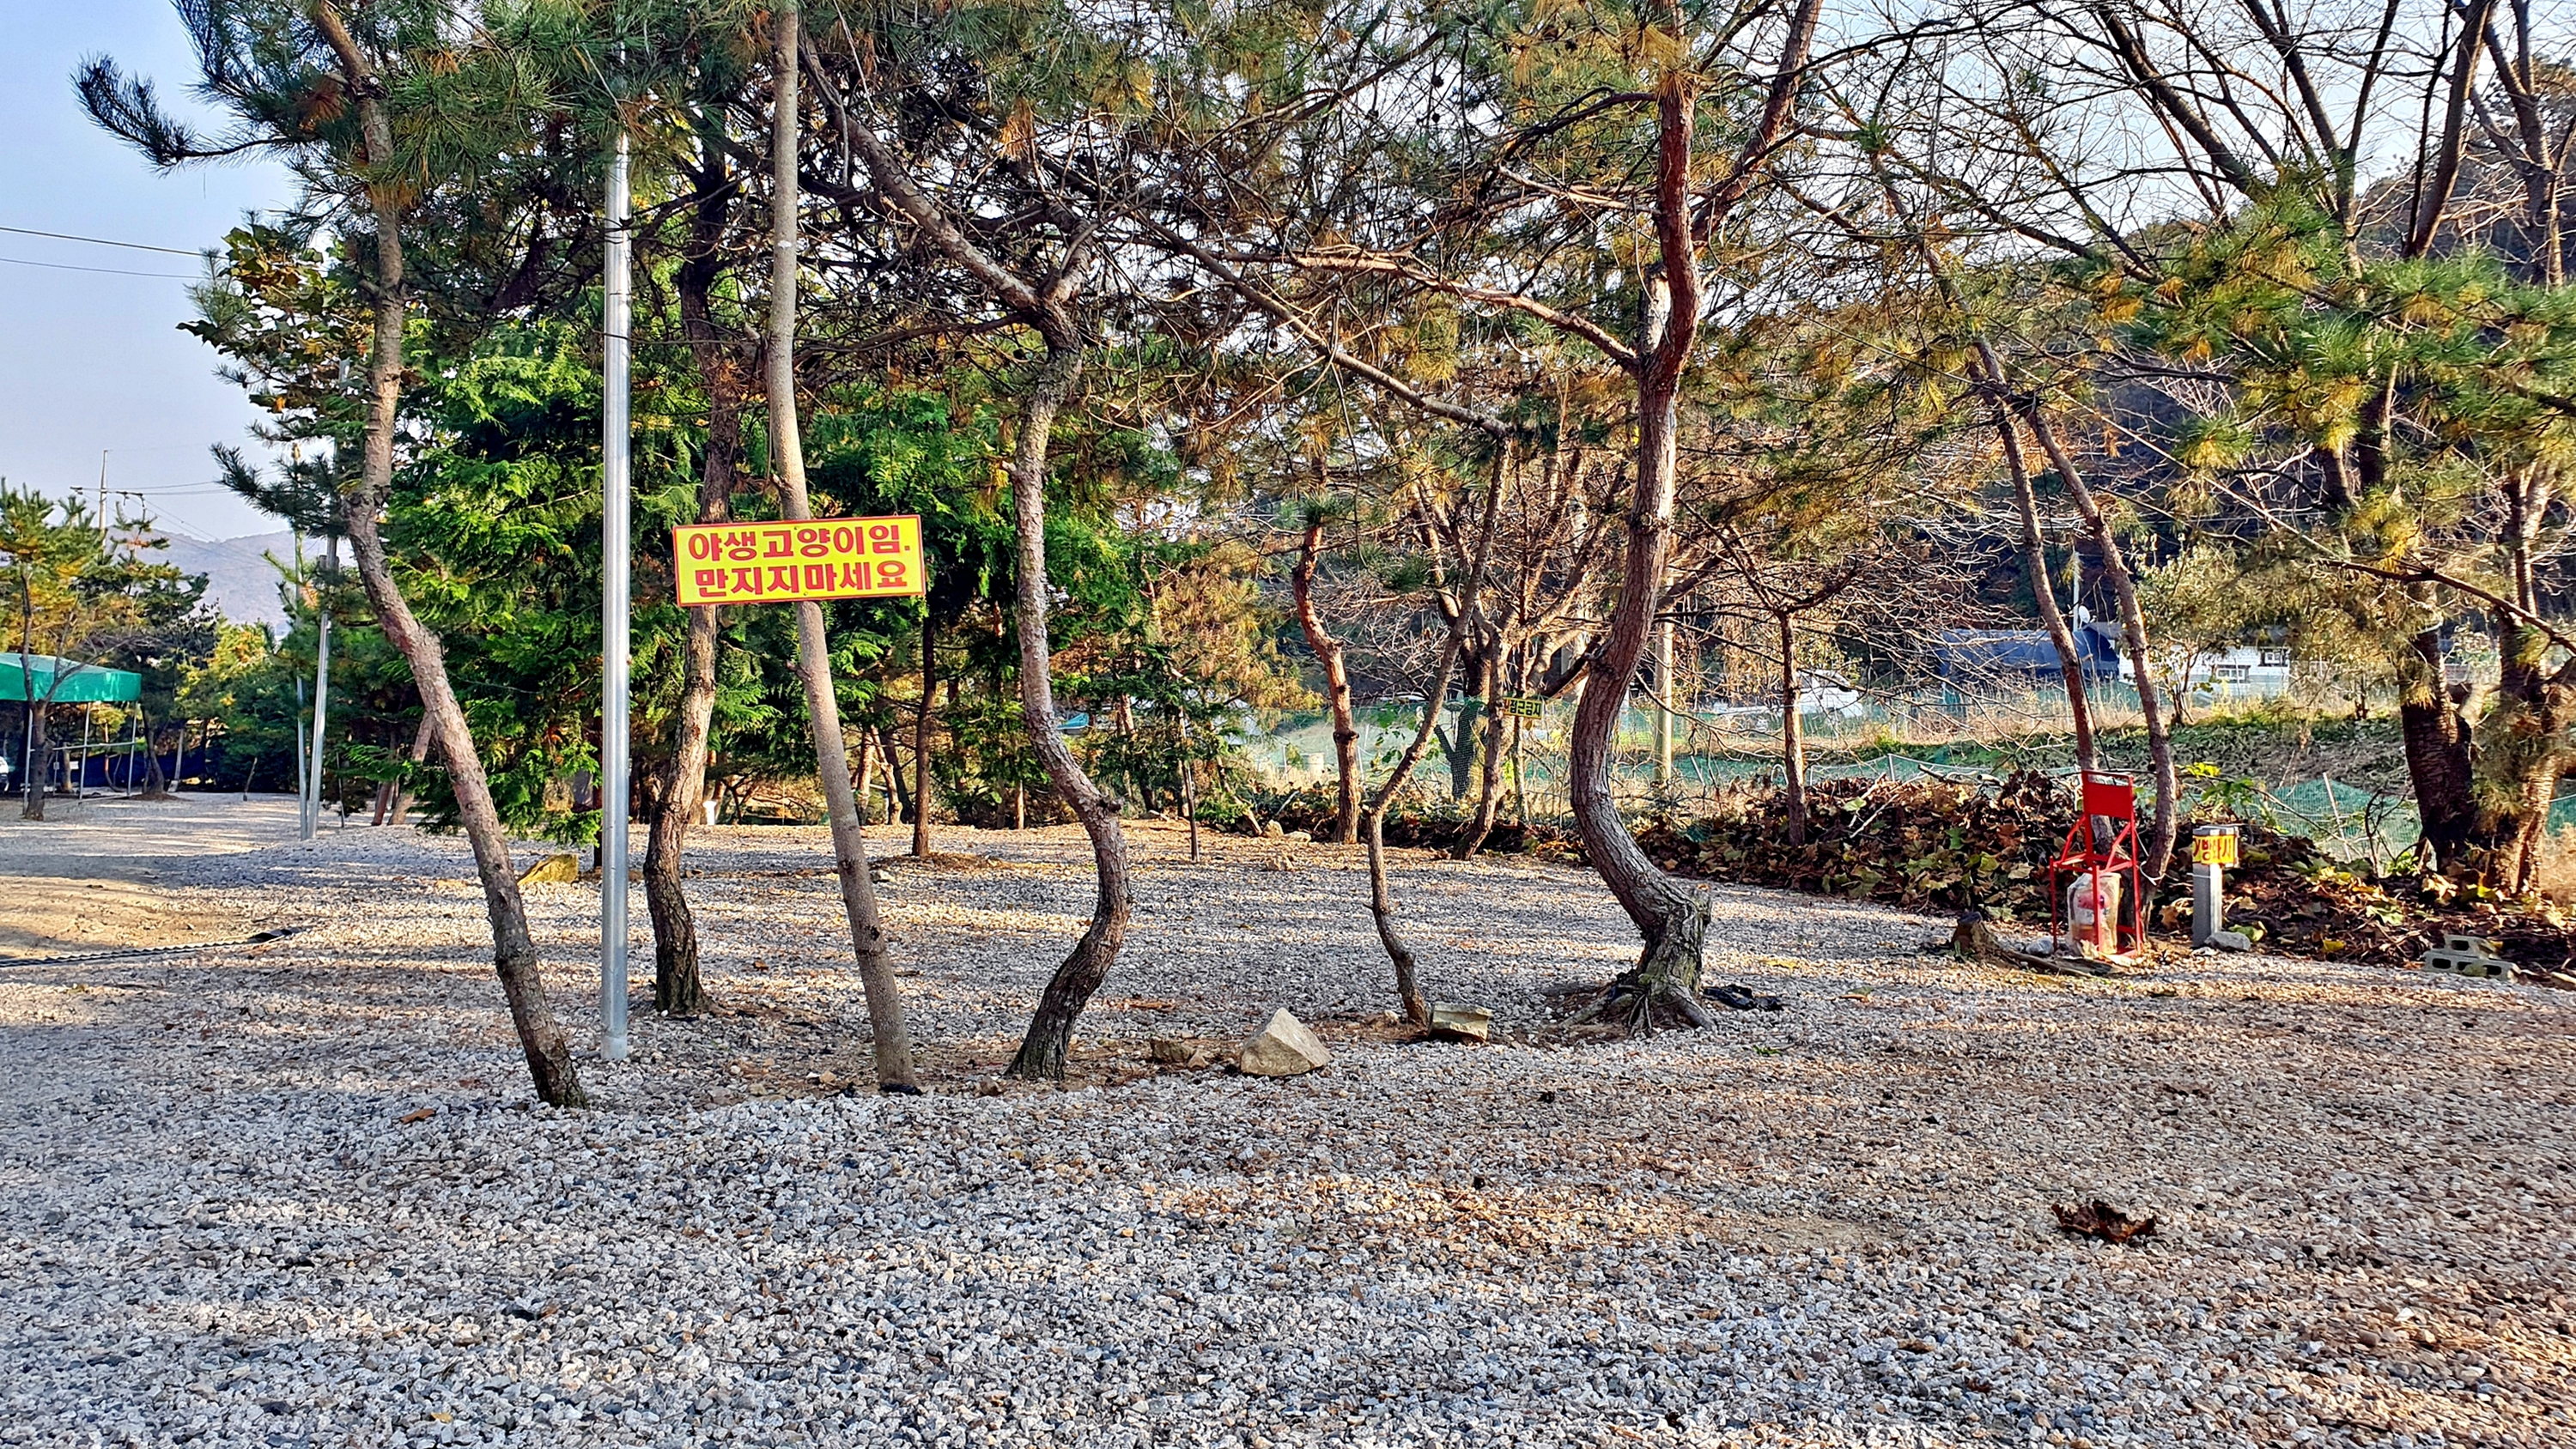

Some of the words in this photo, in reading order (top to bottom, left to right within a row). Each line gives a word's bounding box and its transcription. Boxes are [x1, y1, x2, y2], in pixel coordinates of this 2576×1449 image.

[688, 524, 911, 562] 야생고양이임.
[695, 561, 908, 597] 만지지마세요
[1510, 699, 1541, 717] 접근금지
